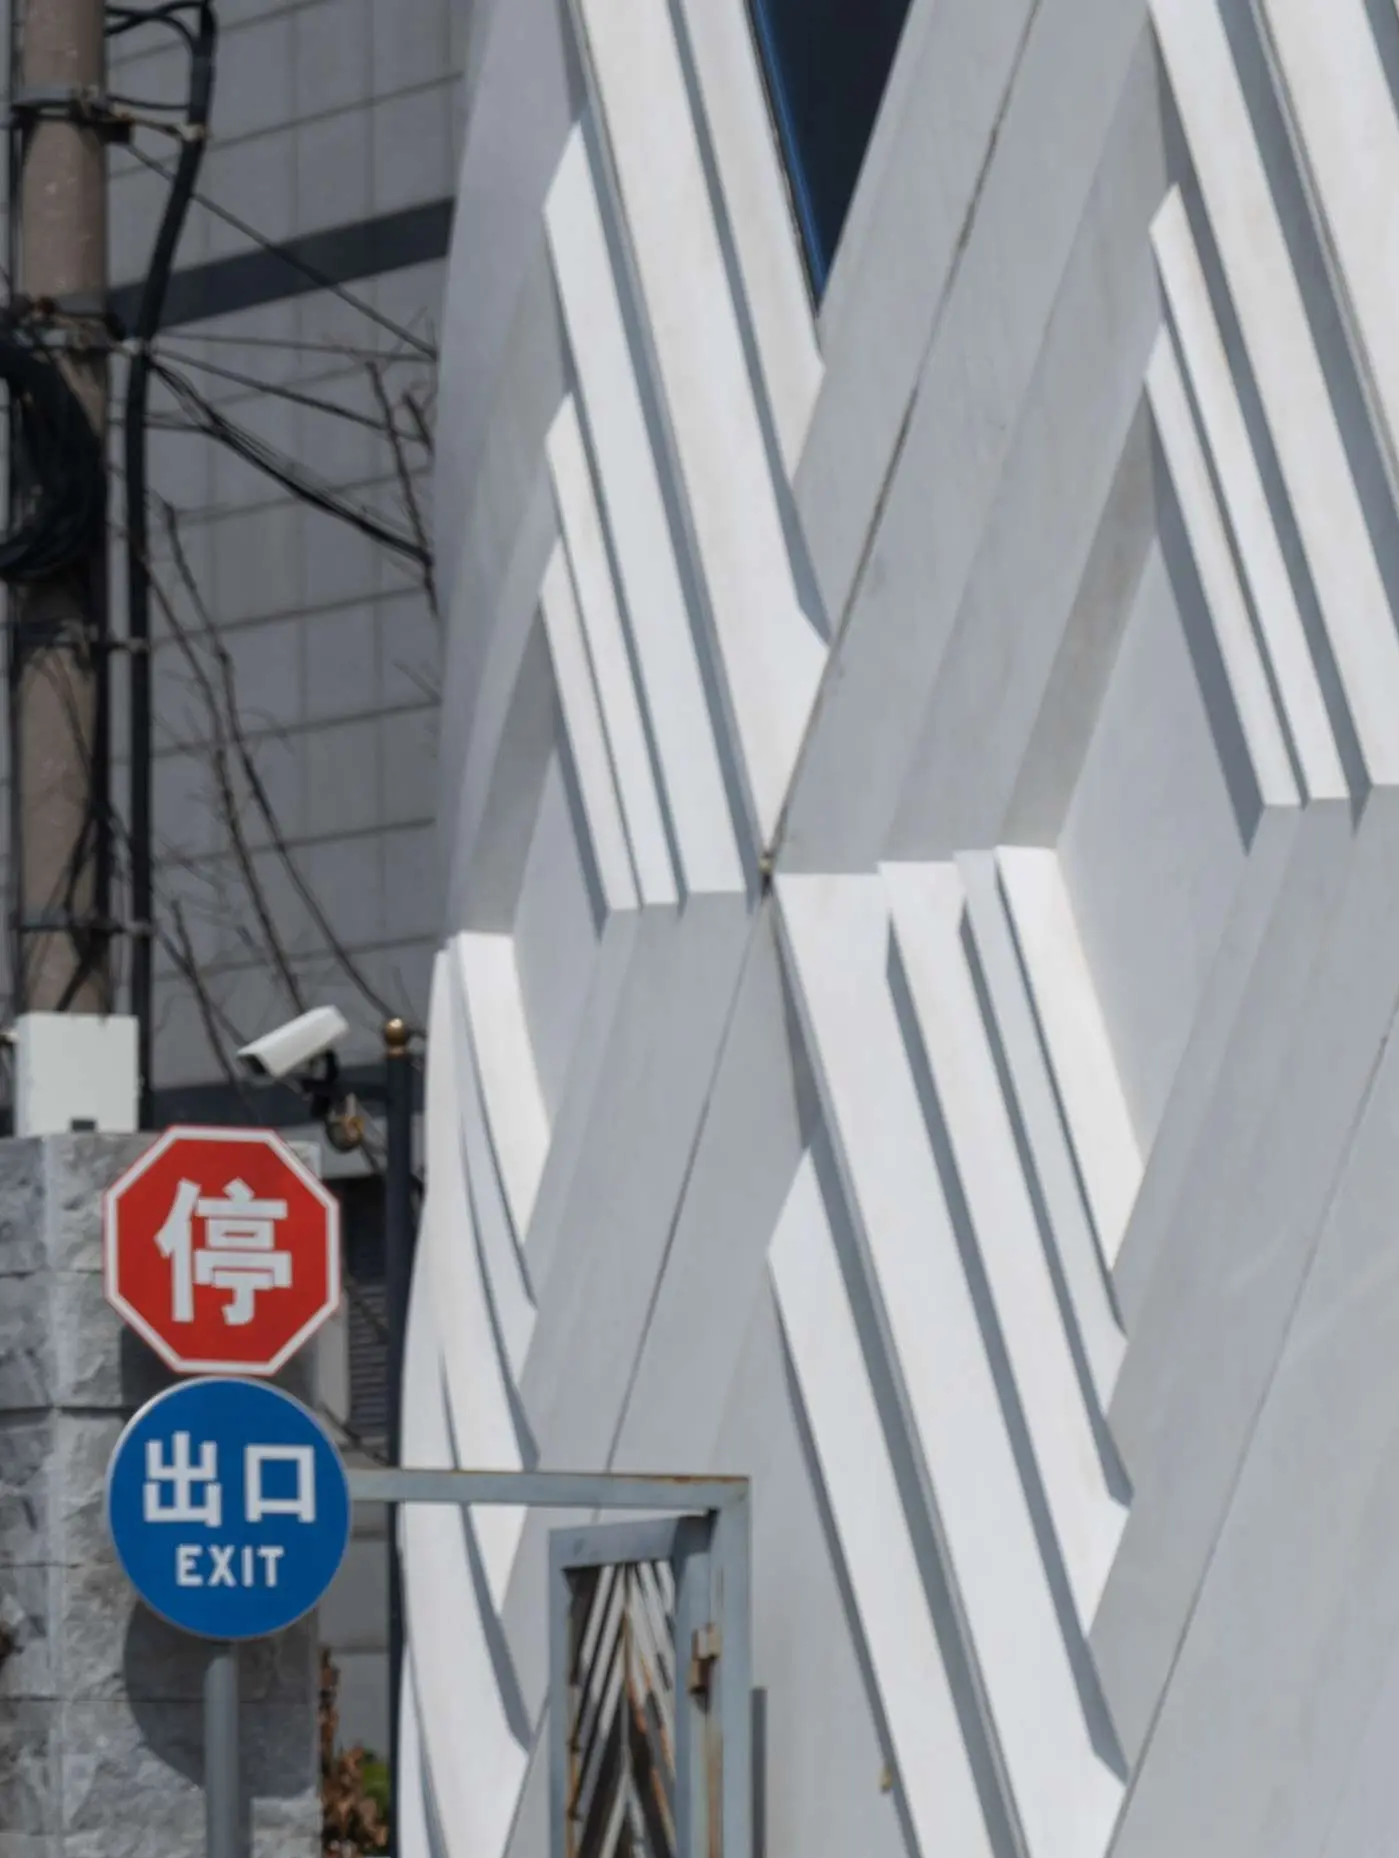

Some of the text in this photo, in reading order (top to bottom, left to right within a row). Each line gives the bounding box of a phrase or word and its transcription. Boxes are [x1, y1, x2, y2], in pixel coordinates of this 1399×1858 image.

[154, 1177, 293, 1326] 停
[143, 1431, 316, 1527] 出口
[175, 1545, 284, 1587] EXIT
